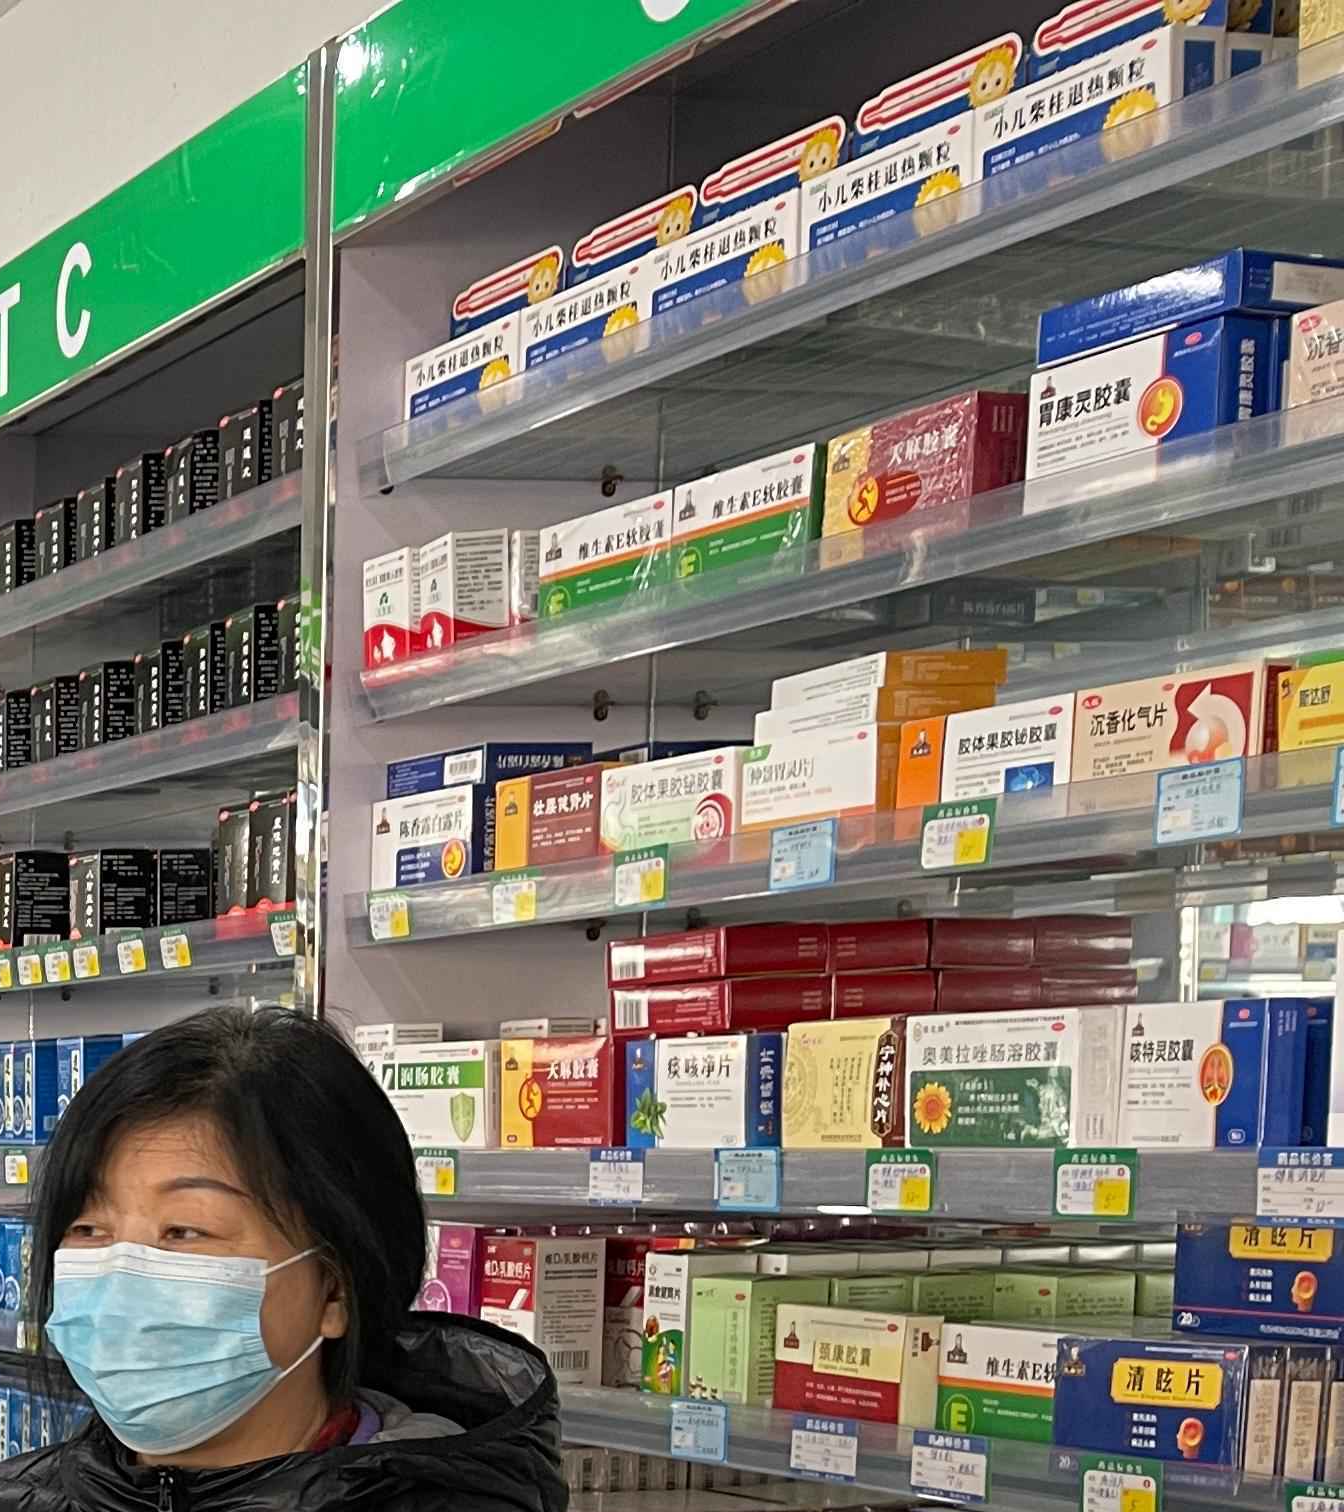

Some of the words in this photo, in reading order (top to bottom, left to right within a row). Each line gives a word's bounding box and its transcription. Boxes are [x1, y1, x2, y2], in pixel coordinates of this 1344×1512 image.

[993, 55, 1146, 140] 小儿柴桂退热颗粒
[817, 141, 952, 213] 小儿柴桂退热颗粒
[658, 214, 780, 282] 小儿柴桂退热颗粒
[531, 280, 632, 338] 小儿柴桂退热颗粒
[415, 334, 505, 387] 小儿柴桂退热颗粒
[1038, 377, 1133, 429] 胃康灵胶囊
[713, 473, 804, 519] 维生素E软胶囊
[957, 723, 1058, 756] 胶体果胶铋胶囊
[1090, 702, 1169, 737] 沉香化气片
[545, 1056, 600, 1080] 天麻胶囊
[666, 1053, 733, 1081] 痰咳净片
[921, 1040, 1060, 1066] 奥美拉唑肠溶胶囊
[1129, 1039, 1195, 1063] 咳特灵胶囊
[400, 1064, 461, 1090] 润肠胶囊
[872, 1044, 896, 1124] 宁神补心片
[1125, 1364, 1205, 1397] 清眩片
